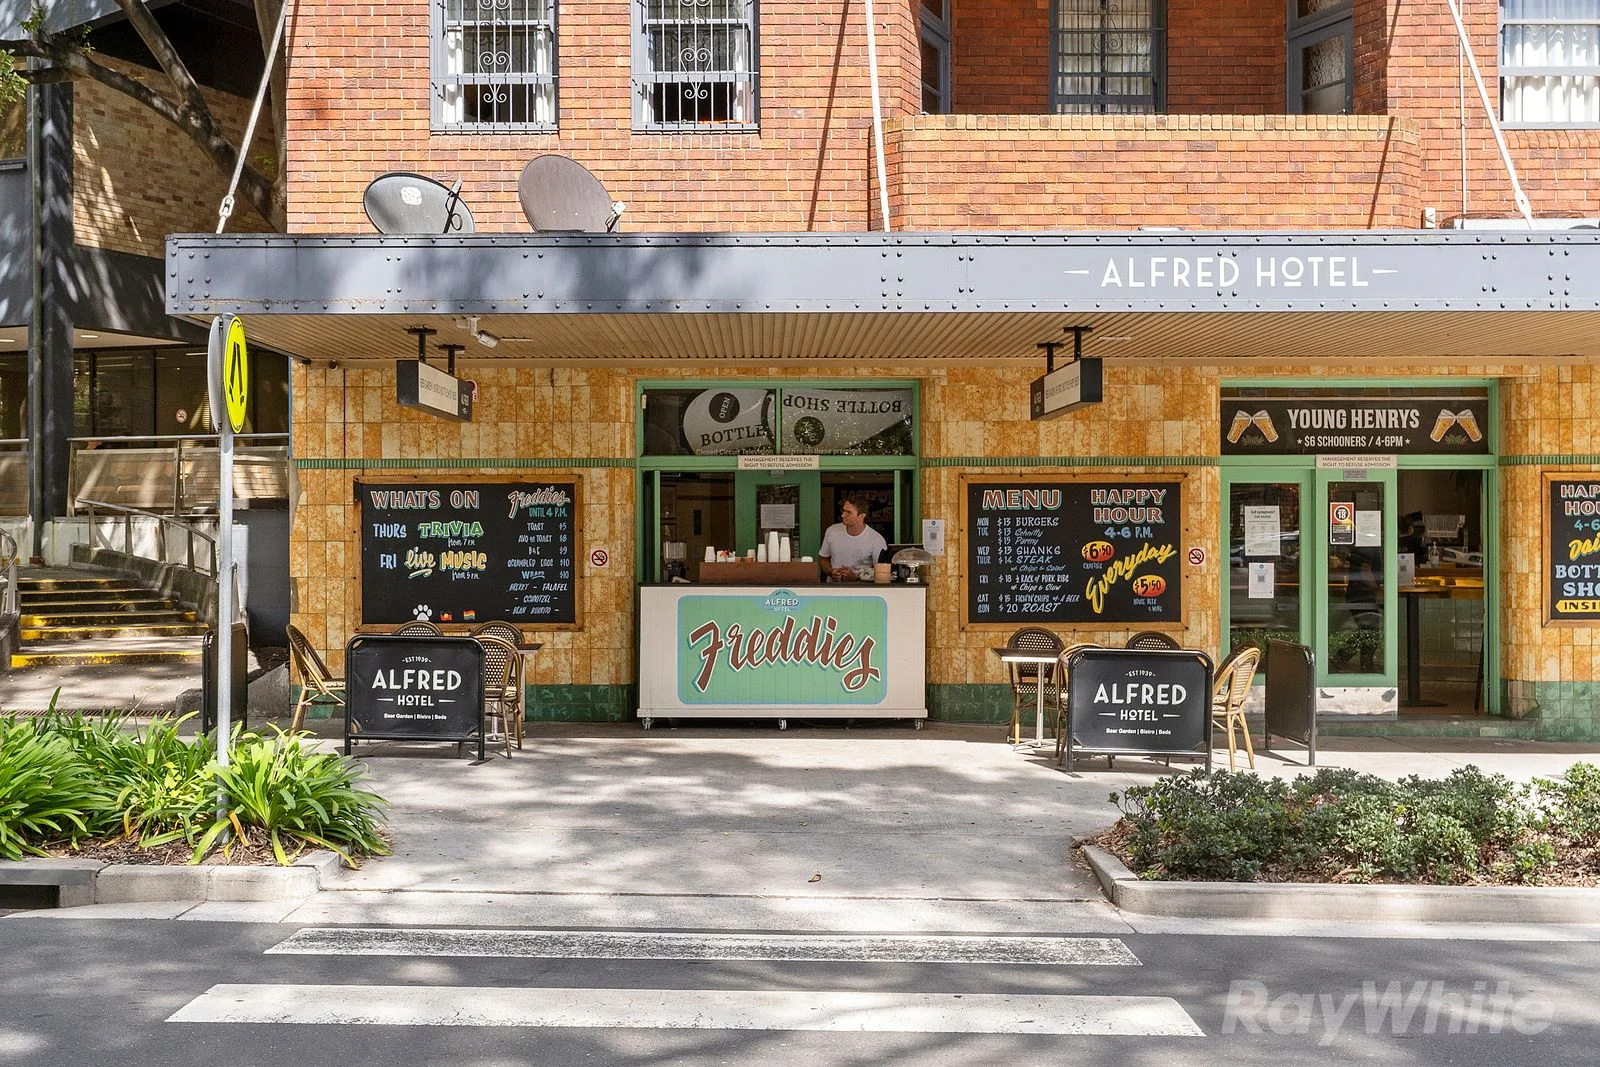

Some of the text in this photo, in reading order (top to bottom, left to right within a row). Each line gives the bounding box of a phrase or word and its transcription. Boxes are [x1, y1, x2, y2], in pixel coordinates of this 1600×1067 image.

[1101, 256, 1369, 288] ALFRED HOTEL
[719, 397, 731, 419] OPEN
[783, 395, 902, 413] BOTTLE SHOP
[1287, 408, 1420, 429] YOUNG HENRYS
[700, 424, 766, 447] BOTTLE
[1304, 435, 1316, 447] $6
[1317, 435, 1367, 447] SCHOONERS
[1375, 435, 1403, 447] 4-6PM
[742, 448, 774, 456] Television
[370, 490, 480, 510] WHATS ON
[507, 485, 571, 519] Freddies
[982, 489, 1062, 511] MENU
[1090, 489, 1167, 506] HAPPY
[529, 507, 545, 517] UNTIL
[545, 507, 553, 517] 4
[1093, 507, 1165, 524] HOUR
[526, 522, 567, 531] TOAST $5
[977, 517, 989, 527] MON
[1015, 517, 1060, 527] BURGERS
[372, 520, 485, 538] THURS TRIVIA
[977, 527, 989, 536] TUE
[1104, 526, 1131, 539] 4-6
[518, 534, 528, 543] AVO
[536, 534, 552, 543] TOAST
[559, 546, 568, 555] $9
[977, 546, 990, 556] WED
[1016, 546, 1061, 555] SHANKS
[380, 546, 488, 572] FRI live MUSIC
[1015, 555, 1053, 564] STEAK
[979, 574, 989, 584] FRI
[1020, 575, 1034, 583] RACK
[1041, 574, 1056, 583] PORK
[1085, 542, 1178, 614] Everyday
[542, 582, 568, 591] FALAFEL
[1019, 583, 1038, 592] Chips
[765, 598, 800, 606] ALFRED
[977, 594, 989, 603] SAT
[977, 604, 990, 613] SUN
[1021, 602, 1062, 613] ROAST
[688, 615, 881, 694] Freddies
[371, 669, 462, 691] ALFRED
[1093, 682, 1188, 706] ALFRED
[397, 695, 435, 707] HOTEL
[1120, 709, 1159, 721] HOTEL
